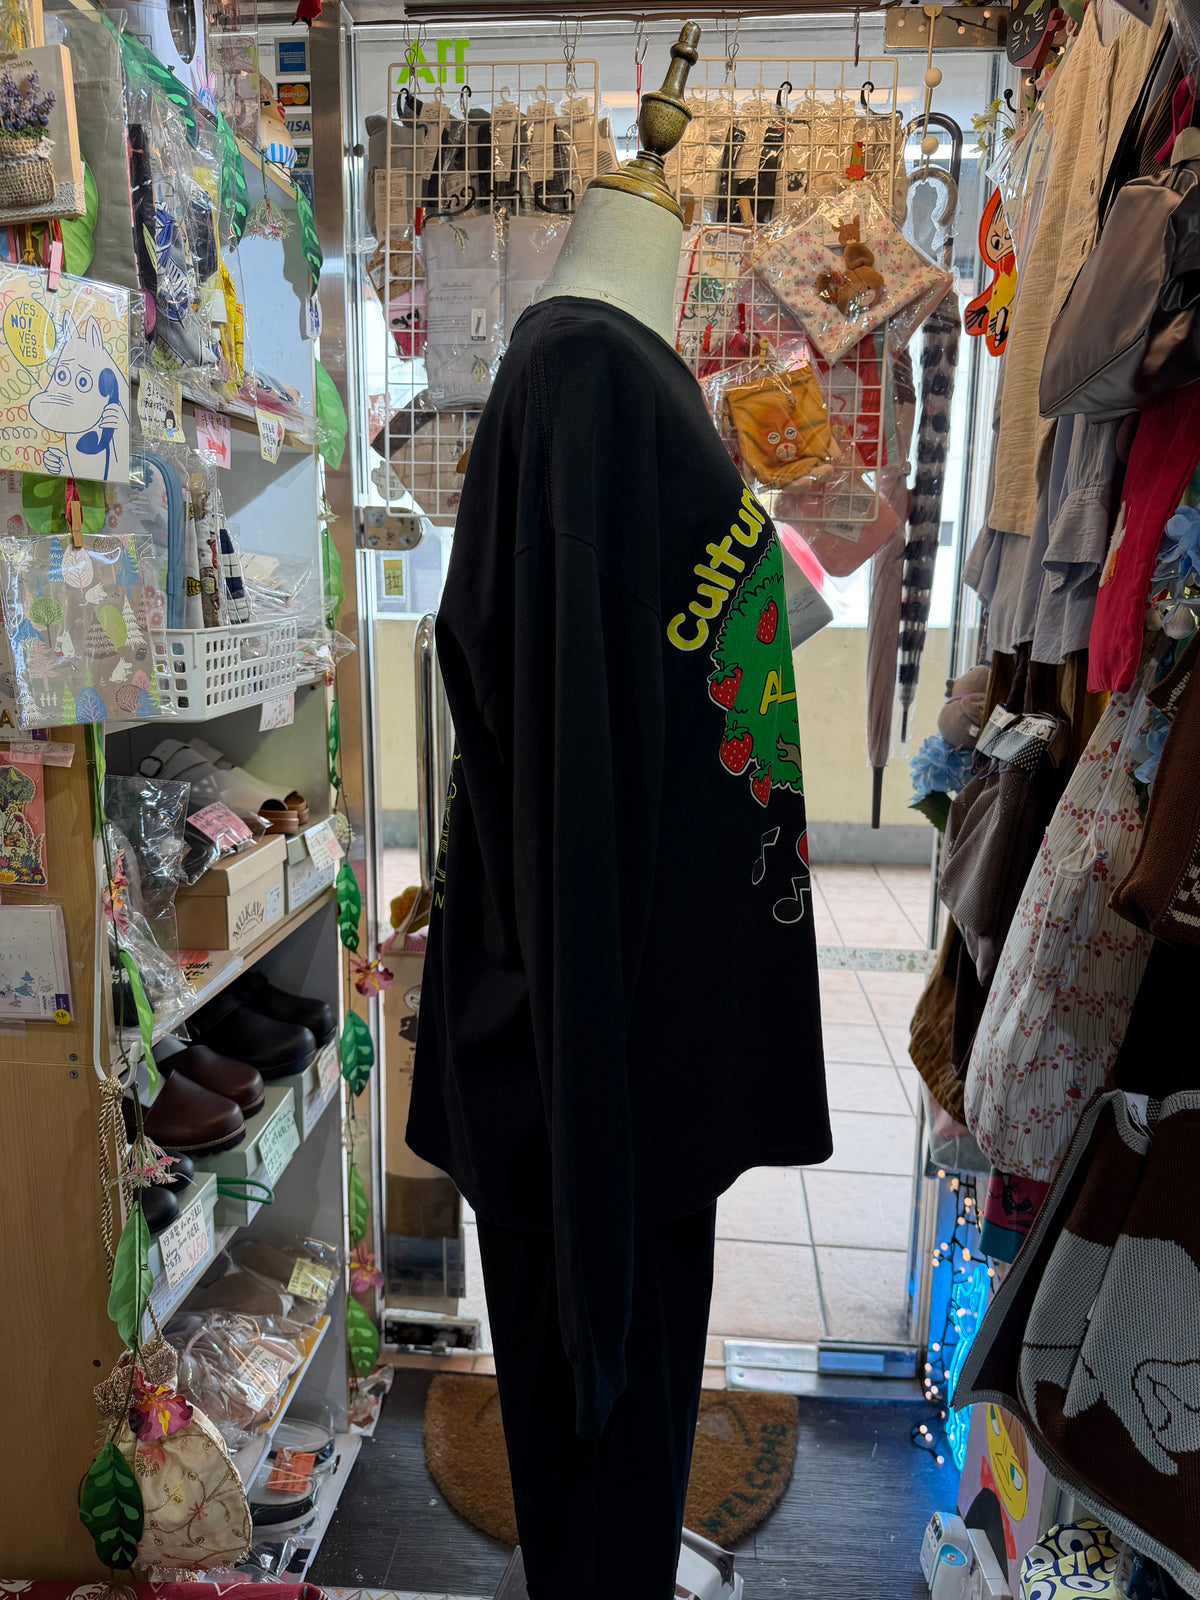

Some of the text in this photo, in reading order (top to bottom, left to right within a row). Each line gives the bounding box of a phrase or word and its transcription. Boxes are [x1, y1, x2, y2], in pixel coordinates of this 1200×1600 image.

[8, 60, 33, 69] TOMITA
[285, 120, 311, 132] VISA
[666, 475, 766, 651] Cultur
[232, 900, 265, 941] MUKAVA
[698, 1423, 787, 1535] WELCOME
